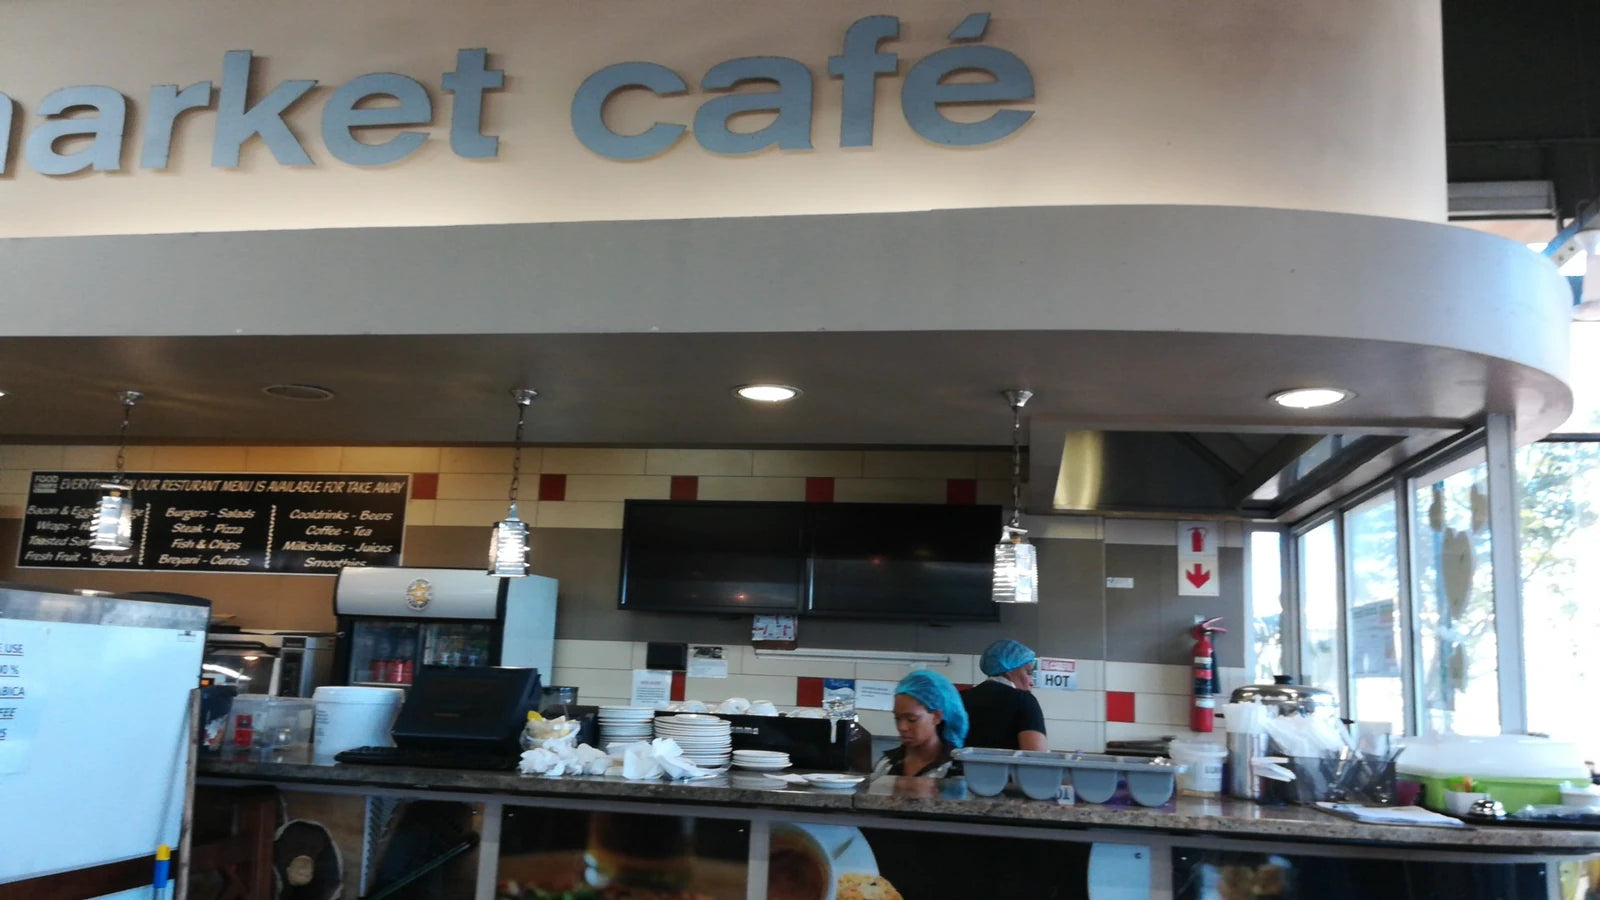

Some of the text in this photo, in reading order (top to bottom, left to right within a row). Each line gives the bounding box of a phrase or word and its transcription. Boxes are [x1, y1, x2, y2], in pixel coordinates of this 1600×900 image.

[571, 12, 1036, 161] café
[137, 479, 161, 491] OUR
[161, 480, 221, 492] RESTURANT
[221, 480, 253, 492] MENU
[253, 481, 266, 492] IS
[266, 481, 321, 493] AVAILABLE
[322, 482, 346, 493] FOR
[346, 482, 374, 493] TAKE
[374, 482, 405, 493] AWAY
[27, 505, 60, 515] Bacon
[60, 506, 70, 516] &
[165, 507, 209, 521] Burgers
[217, 508, 256, 519] Salads
[289, 509, 350, 521] Cooldrinks
[360, 510, 393, 521] Beers
[36, 521, 71, 533] Wraps
[171, 522, 205, 534] Steak
[213, 524, 245, 534] Pizza
[305, 525, 343, 536] Coffee
[353, 526, 373, 537] Tea
[28, 535, 69, 547] Toasted
[170, 538, 242, 552] Fish & Chips
[282, 541, 346, 552] Milkshakes
[354, 542, 394, 553] Juices
[24, 551, 55, 562] Fresh
[55, 551, 81, 562] Fruit
[91, 552, 133, 566] Yoghurt
[158, 553, 202, 567] Breyani
[209, 555, 251, 567] Curries
[304, 557, 367, 568] Smoothies
[1045, 674, 1069, 687] HOT
